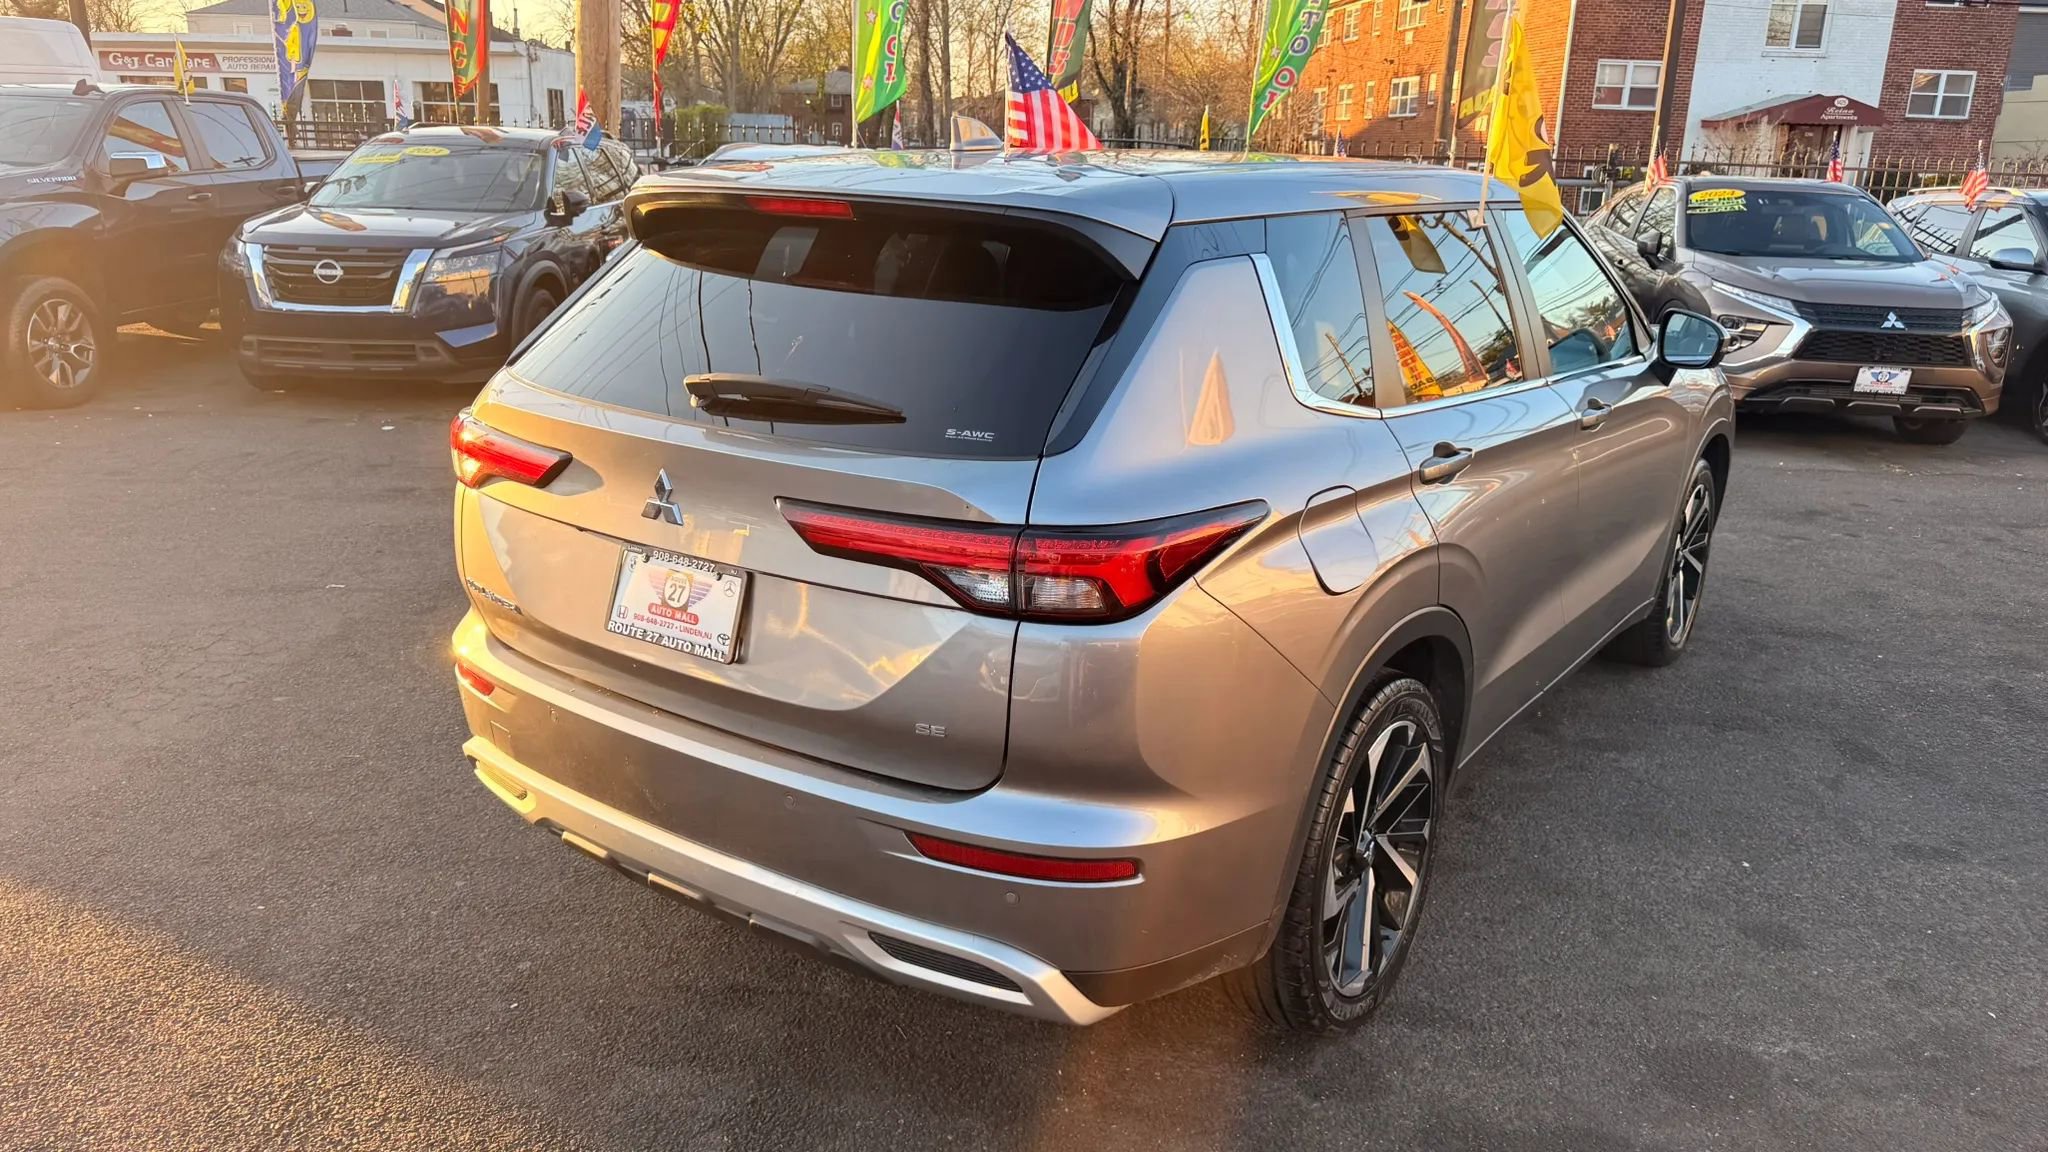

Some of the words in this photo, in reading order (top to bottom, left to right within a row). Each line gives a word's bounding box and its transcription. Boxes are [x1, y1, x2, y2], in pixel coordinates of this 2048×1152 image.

[1699, 190, 1736, 199] 2024
[945, 428, 995, 439] S-AWC
[653, 550, 716, 573] 908-648-2727
[667, 583, 686, 603] 27
[633, 612, 674, 629] 908-648-2727
[650, 605, 672, 617] AUTO
[675, 609, 697, 623] MALL
[608, 621, 644, 638] ROUTE
[646, 631, 659, 643] 27
[661, 636, 692, 652] AUTO
[695, 644, 725, 662] MALL
[915, 723, 945, 737] SE
